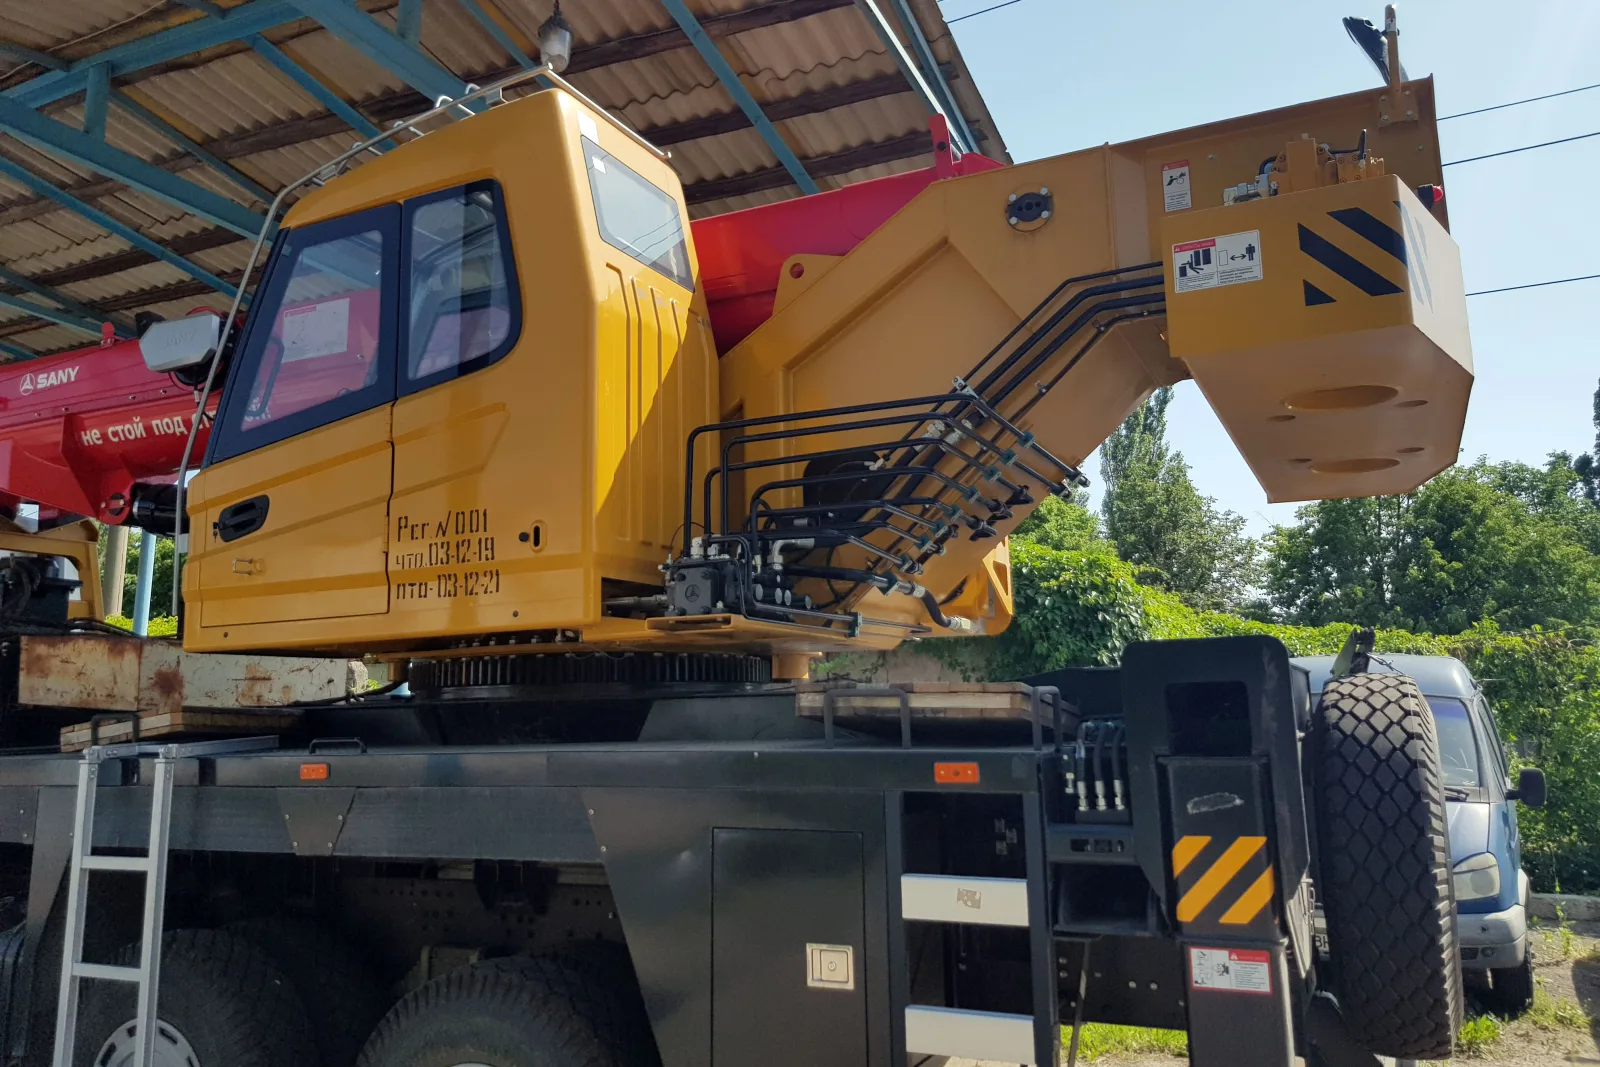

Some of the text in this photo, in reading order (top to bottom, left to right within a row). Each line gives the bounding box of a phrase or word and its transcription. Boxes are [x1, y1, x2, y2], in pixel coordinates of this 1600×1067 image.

[36, 366, 80, 389] SANY
[107, 416, 146, 442] стой
[152, 416, 188, 436] под
